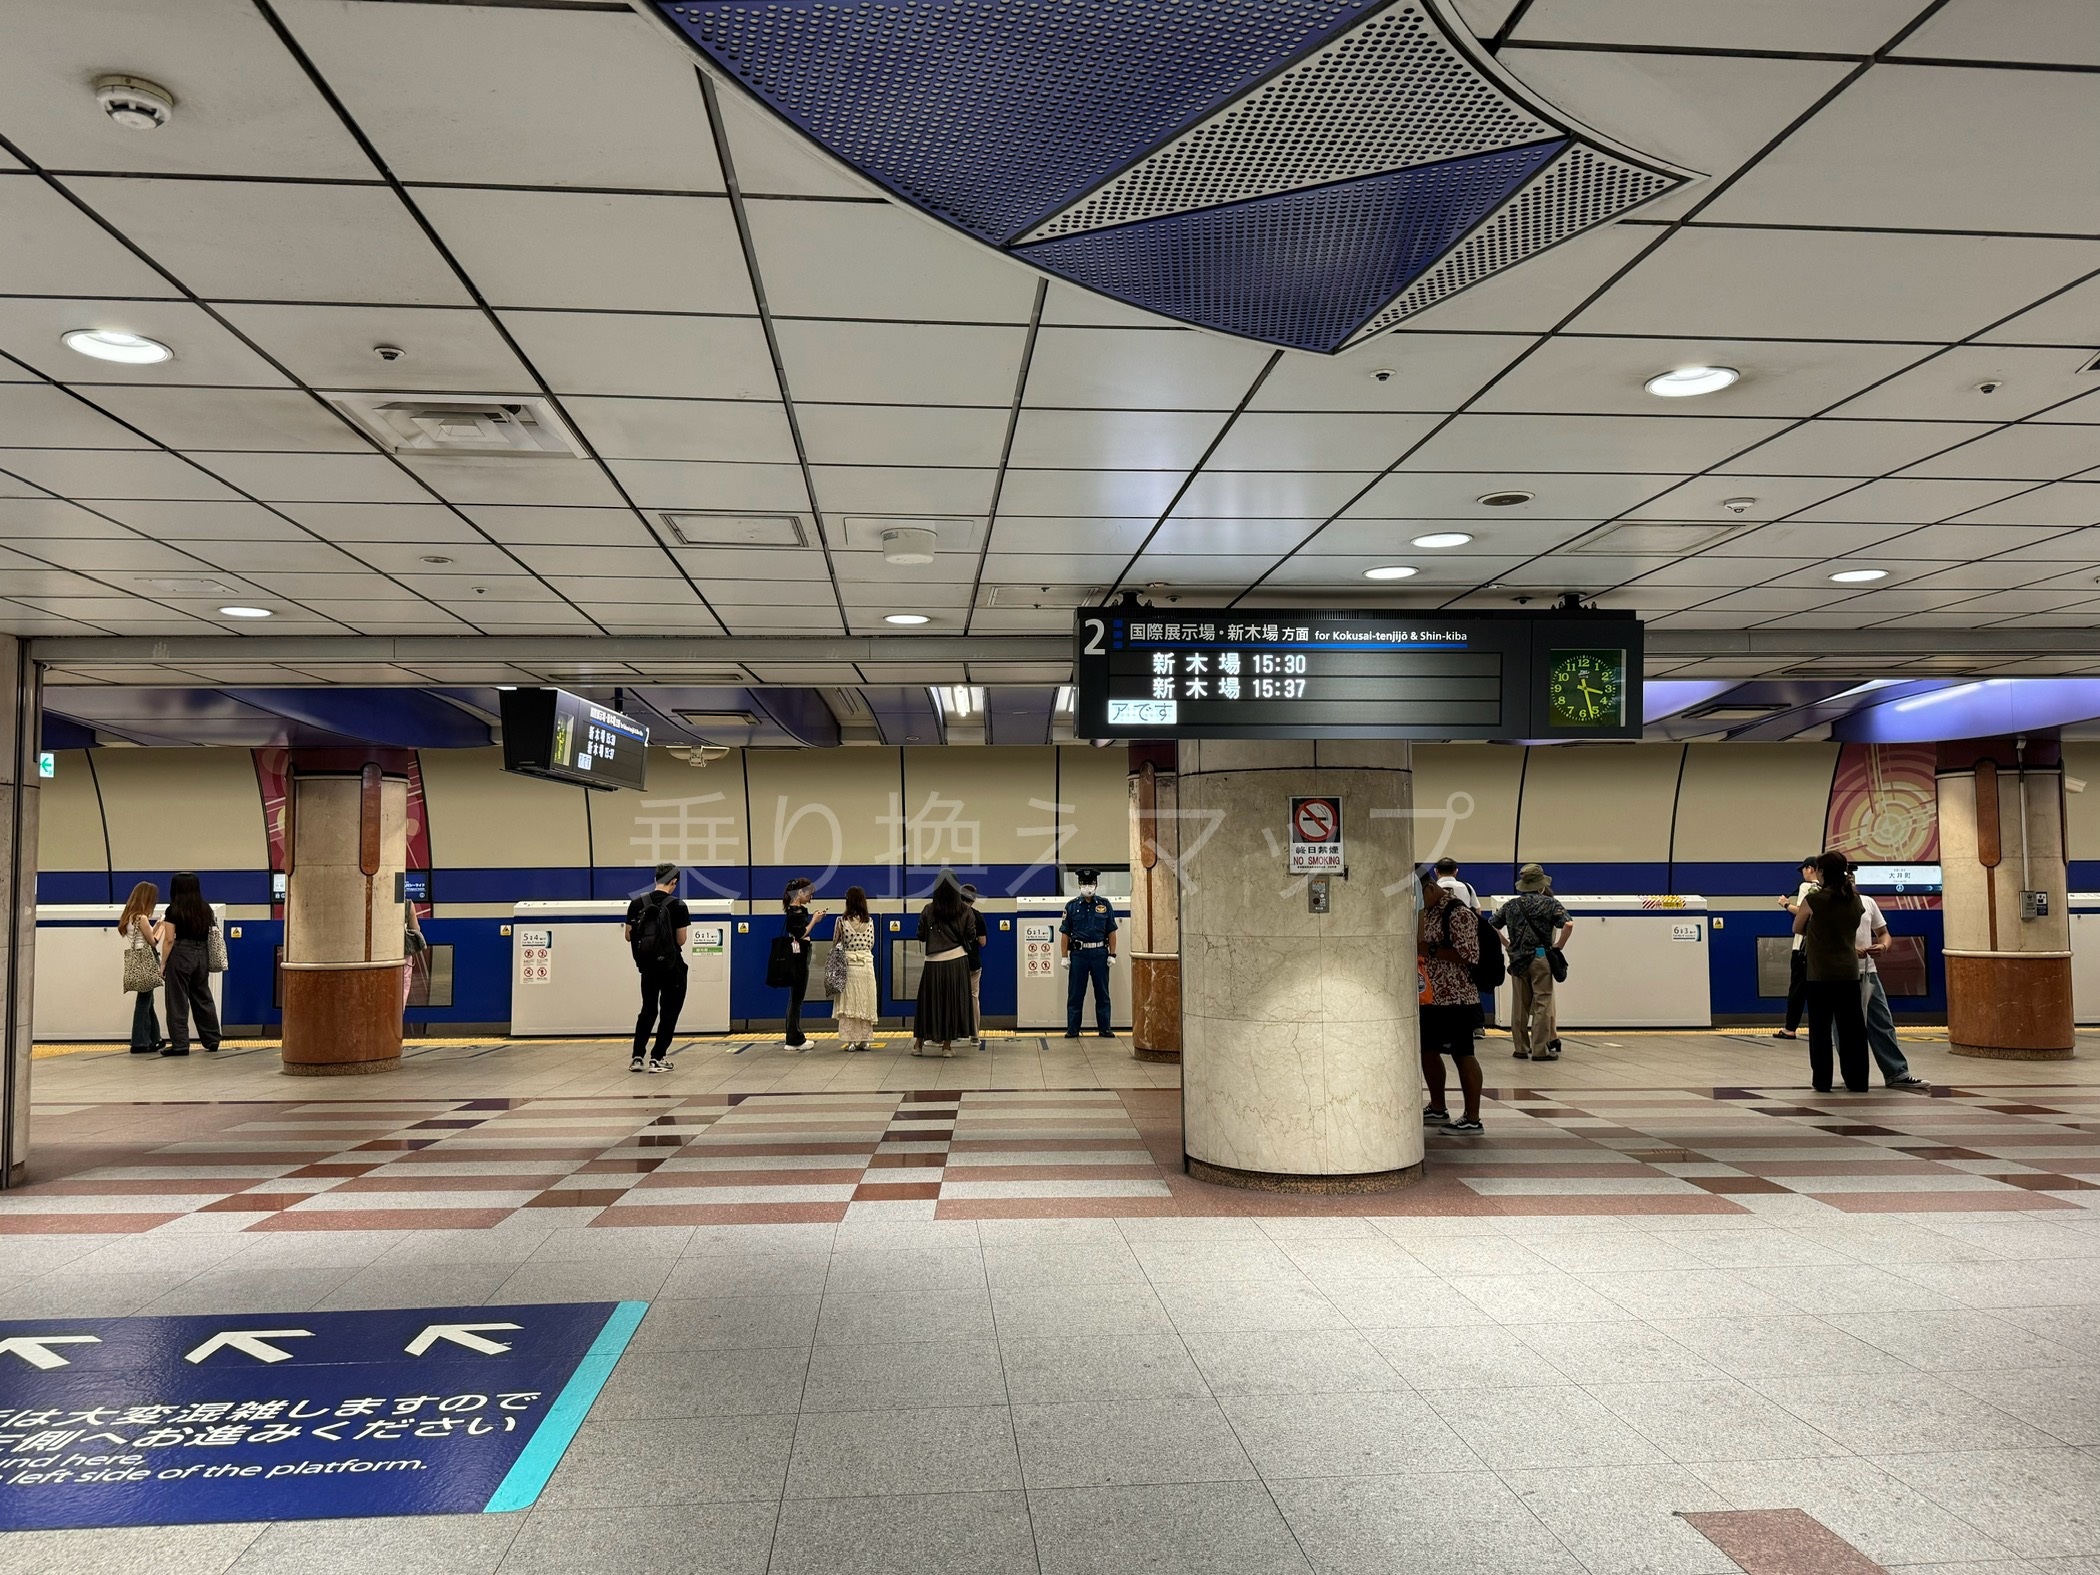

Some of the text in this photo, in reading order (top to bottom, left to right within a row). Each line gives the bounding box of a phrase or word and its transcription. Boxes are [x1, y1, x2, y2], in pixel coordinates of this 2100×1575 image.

[1083, 618, 1106, 655] 2
[1315, 631, 1331, 641] for
[1333, 630, 1408, 643] Kokusai-tenjijō
[1411, 631, 1418, 641] &
[1420, 631, 1468, 641] Shin-kiba
[1252, 654, 1306, 674] 15:30
[1578, 659, 1590, 667] 12
[1558, 672, 1569, 681] 10
[1601, 672, 1609, 681] 2
[1252, 678, 1306, 698] 15:37
[1605, 684, 1612, 693] 3
[1558, 696, 1566, 705] 8
[1600, 696, 1608, 705] 4
[1111, 702, 1173, 722] アです
[1592, 706, 1599, 714] 5
[1295, 845, 1339, 855] 終日禁煙
[1293, 856, 1340, 865] NO SMOKING
[59, 1453, 147, 1468] here,
[6, 1458, 428, 1485] left side of the platform.
